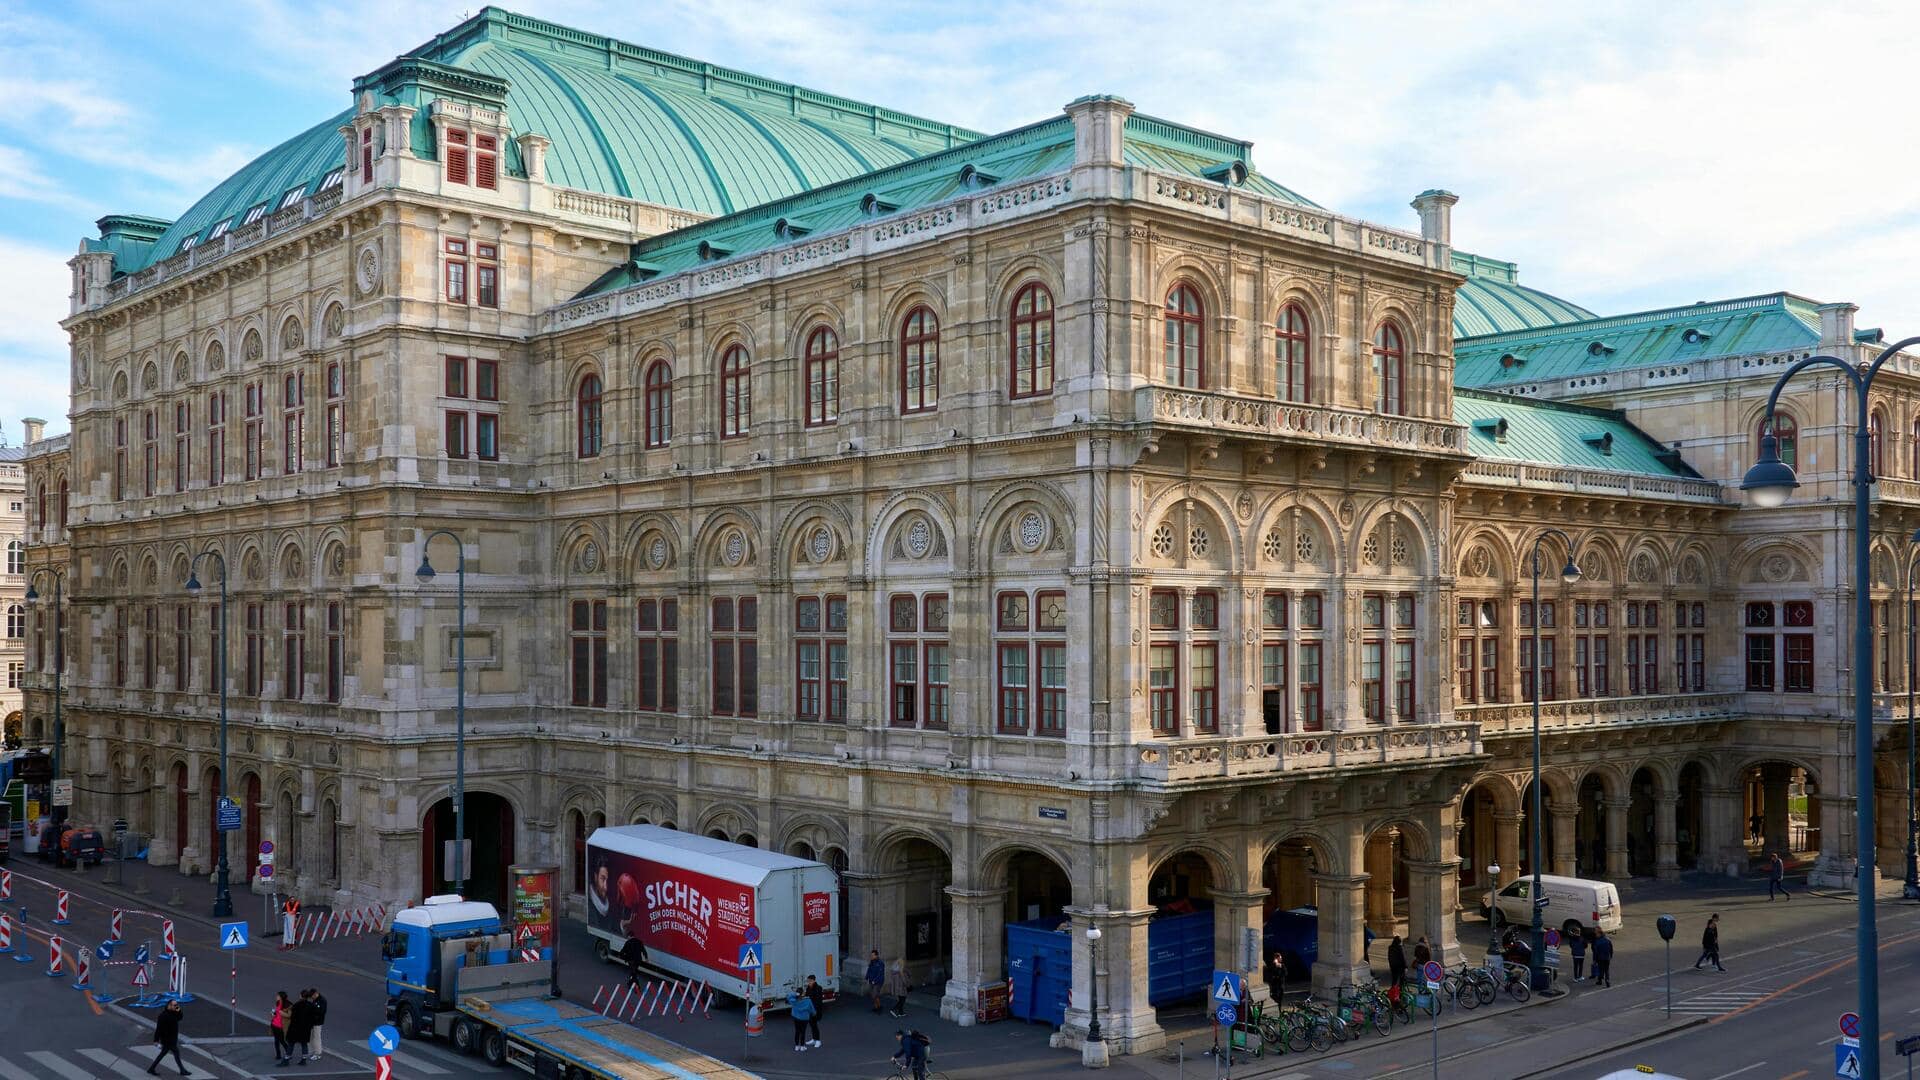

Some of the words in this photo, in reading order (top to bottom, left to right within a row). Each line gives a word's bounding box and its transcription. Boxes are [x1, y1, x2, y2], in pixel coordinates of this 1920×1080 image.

[645, 880, 713, 928] SICHER
[717, 896, 740, 912] WIENER
[661, 909, 676, 918] ODER
[676, 910, 694, 925] NICHT
[651, 922, 662, 934] DAS
[662, 921, 670, 930] IST
[670, 920, 687, 934] KEINE
